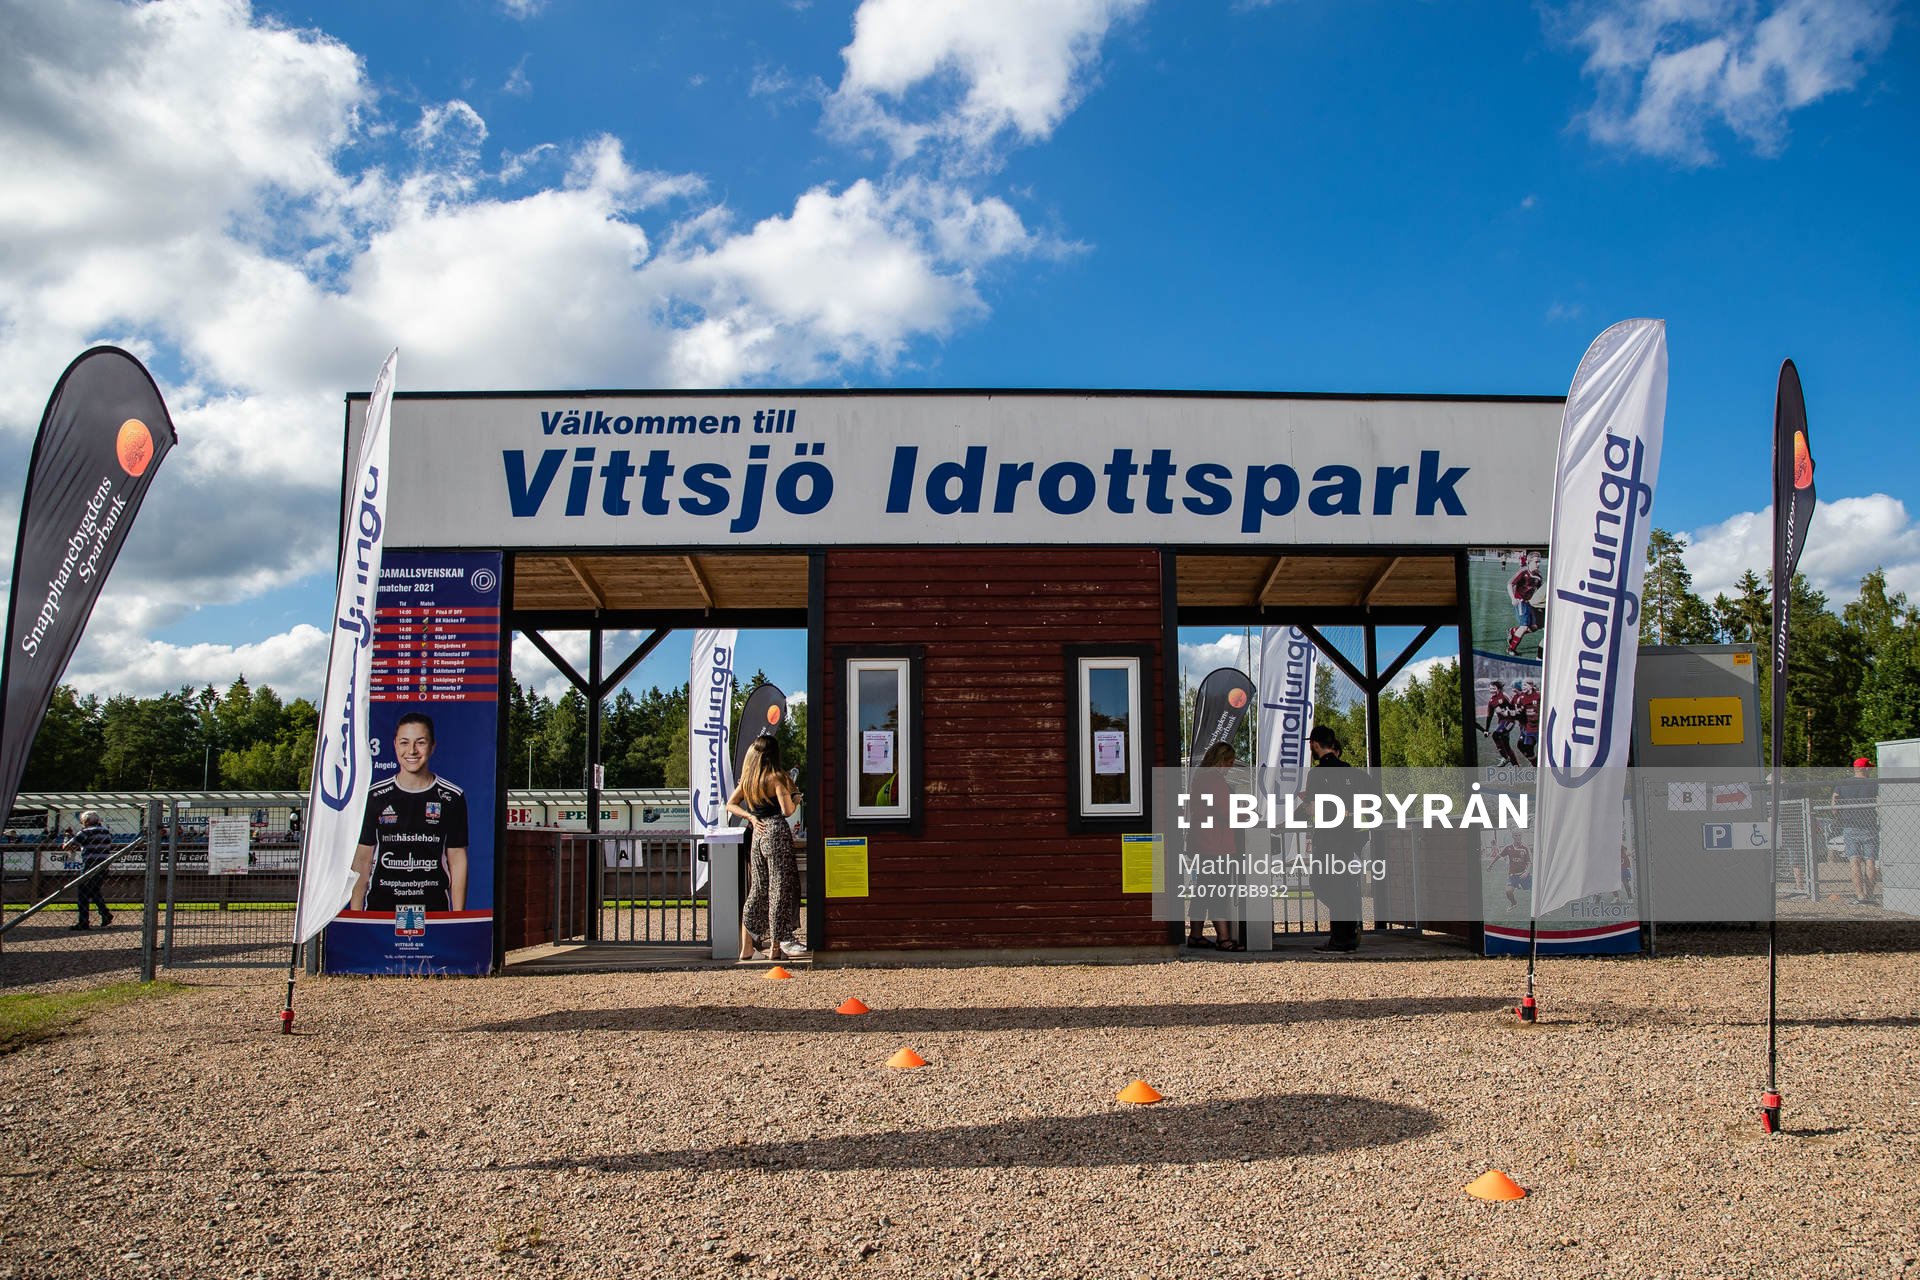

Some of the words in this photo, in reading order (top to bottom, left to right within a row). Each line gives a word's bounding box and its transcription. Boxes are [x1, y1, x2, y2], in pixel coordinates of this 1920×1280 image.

[541, 410, 741, 436] Välkommen
[753, 409, 797, 435] till
[502, 442, 834, 534] Vittsjö
[885, 445, 1471, 534] Idrottspark
[78, 493, 127, 586] Sparbank
[21, 475, 114, 659] Snapphanebygdens
[376, 583, 412, 593] matcher
[414, 583, 434, 593] 2021
[1546, 433, 1652, 789] Emmaljunga
[1661, 714, 1732, 728] RAMIRENT
[374, 761, 397, 770] Angelo
[1683, 792, 1693, 803] B
[565, 811, 611, 820] PEB
[619, 850, 629, 861] A
[380, 879, 439, 889] Snapphanebygdens
[394, 888, 425, 897] Sparbank
[1571, 901, 1631, 918] Flickor
